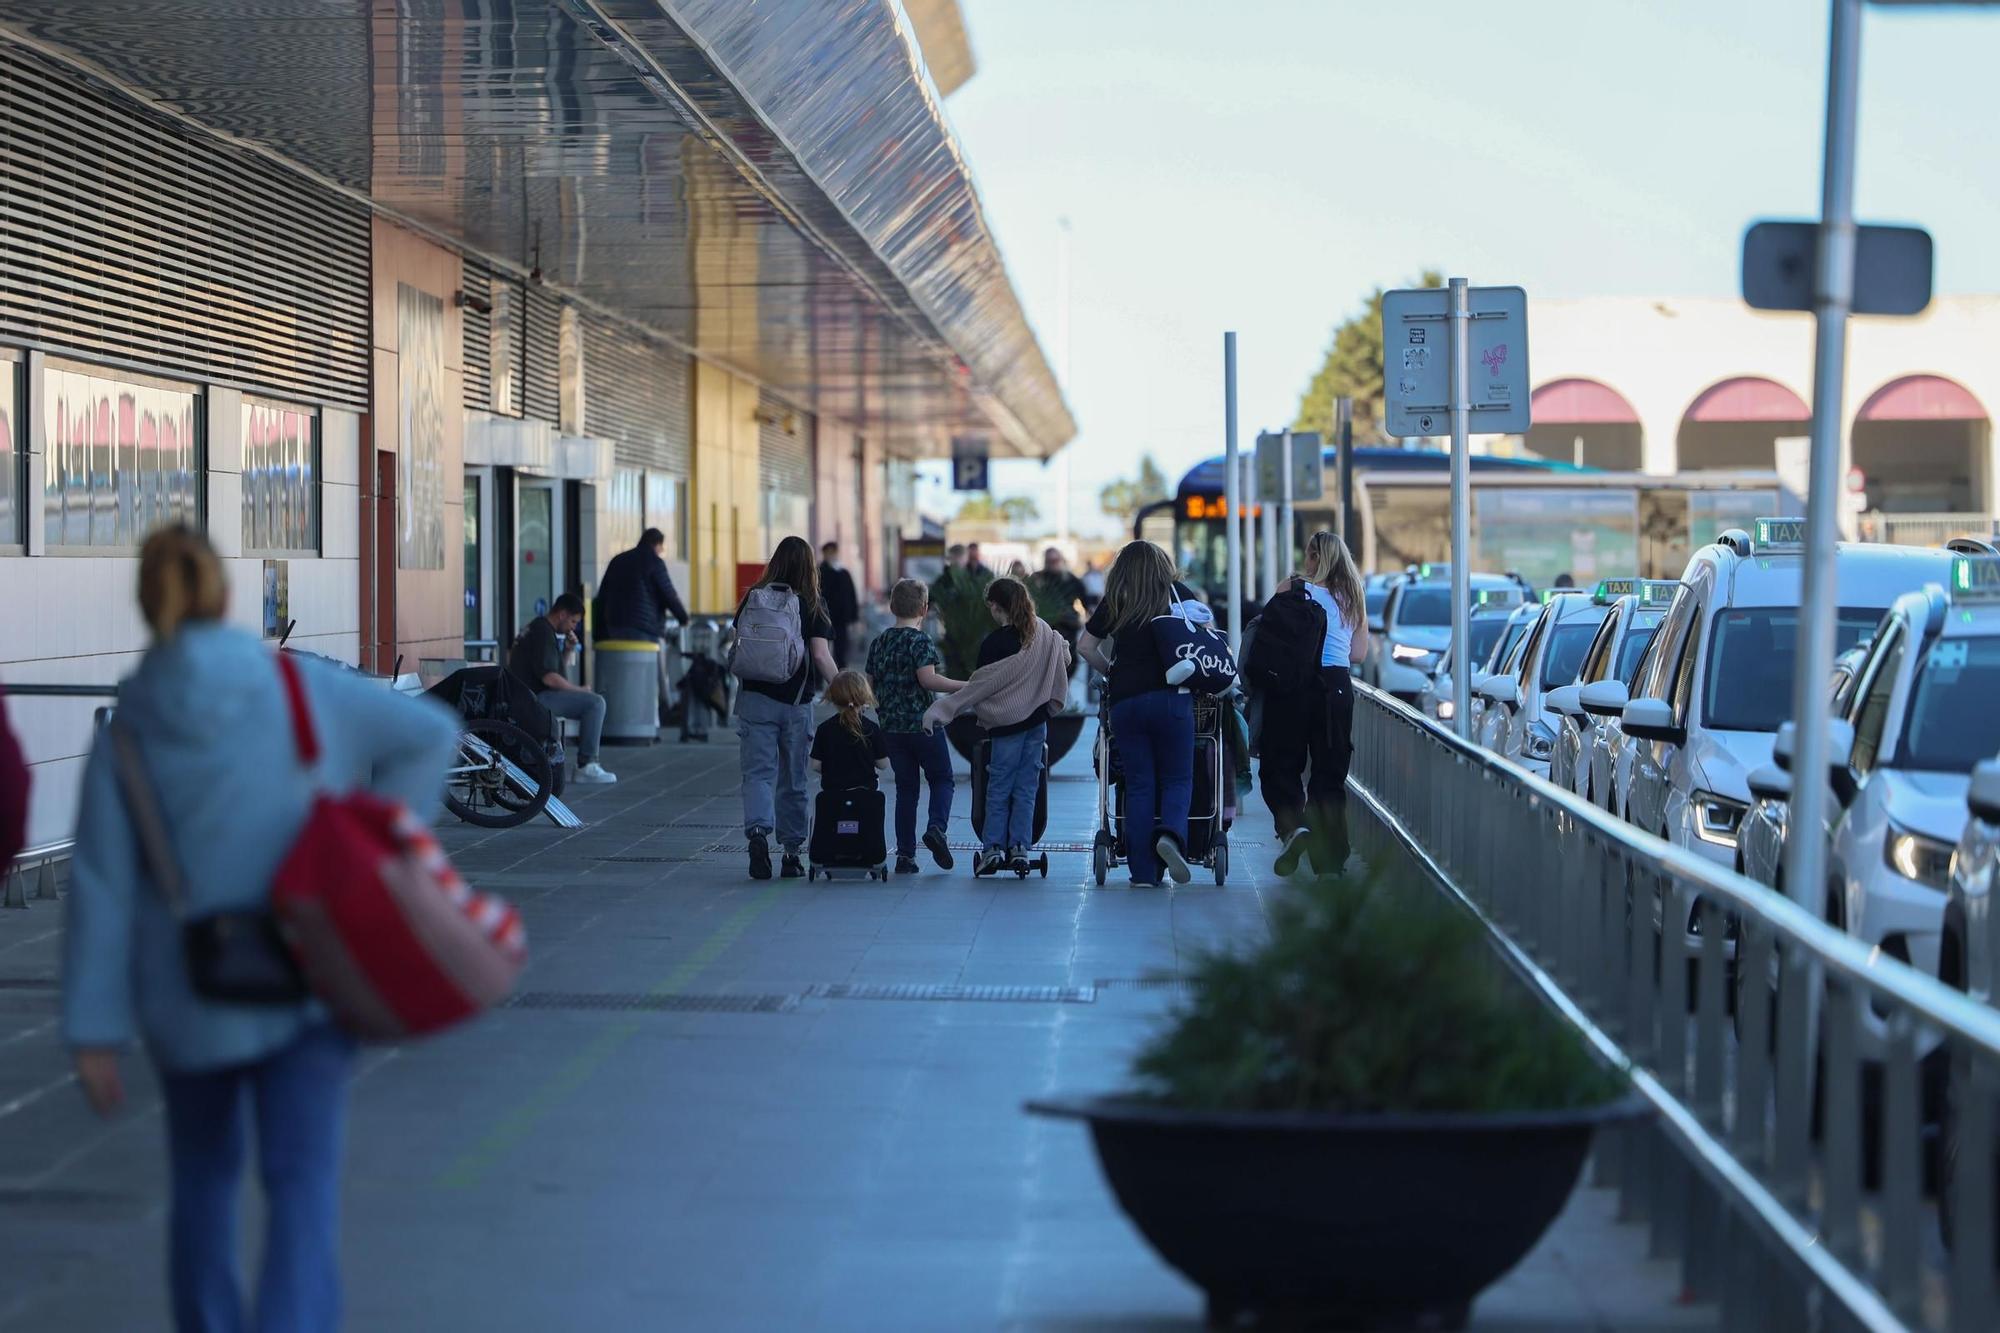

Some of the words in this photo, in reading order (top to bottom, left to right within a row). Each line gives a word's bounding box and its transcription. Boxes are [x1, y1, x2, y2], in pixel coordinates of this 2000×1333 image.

[959, 459, 981, 486] P
[1771, 523, 1806, 542] TAX
[1608, 581, 1632, 594] TAXI
[1176, 642, 1236, 677] Kors
